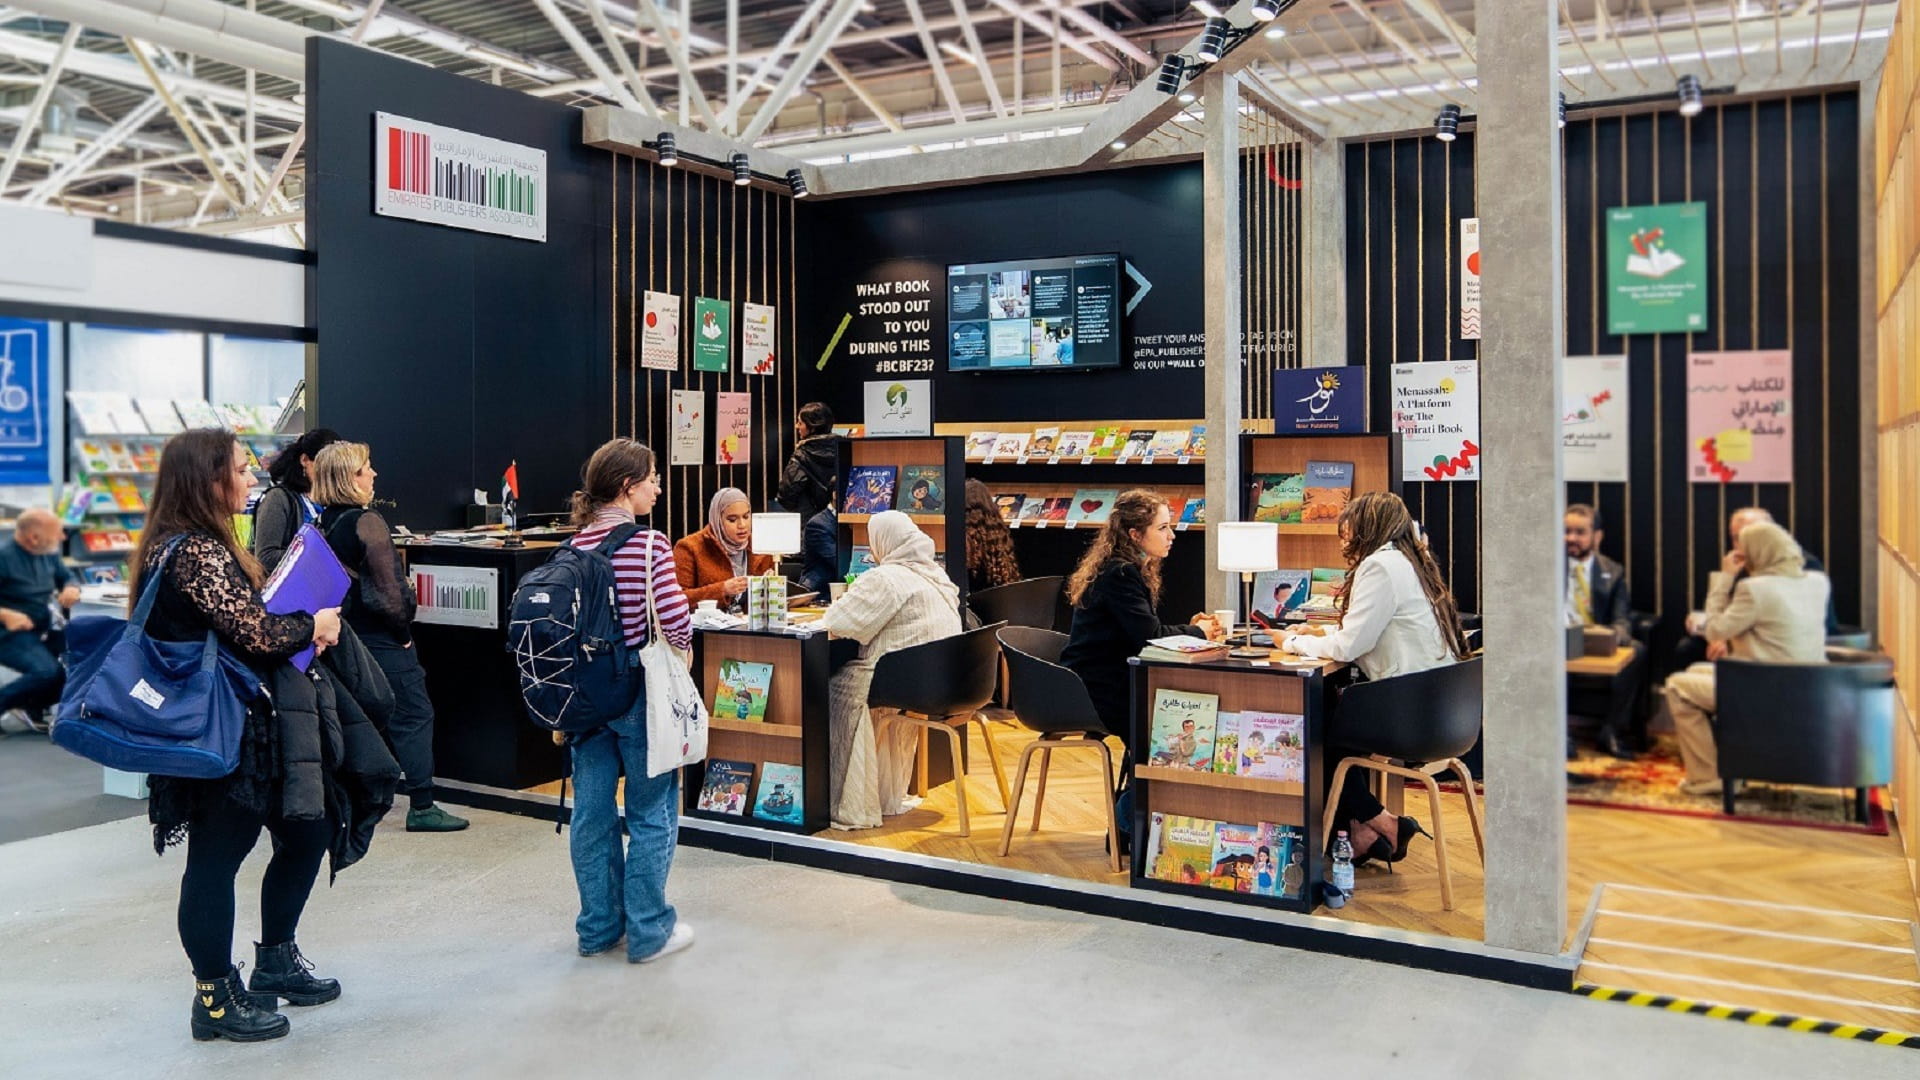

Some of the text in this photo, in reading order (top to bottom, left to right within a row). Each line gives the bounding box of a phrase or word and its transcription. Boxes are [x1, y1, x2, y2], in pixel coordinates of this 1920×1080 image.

[388, 191, 538, 229] EMIRATES PUBLISHERS ASSOCIATION
[856, 280, 930, 296] WHAT BOOK
[859, 300, 930, 315] STOOD OUT
[883, 319, 930, 334] TO YOU
[1134, 335, 1162, 344] TWEET
[1164, 334, 1187, 343] YOUR
[1189, 333, 1205, 343] ANS
[849, 339, 930, 355] DURING THIS
[876, 359, 934, 373] #BCBF23?
[1133, 361, 1146, 370] ON
[1147, 360, 1165, 370] OUR
[1397, 386, 1449, 397] Menassah:
[1408, 398, 1451, 409] Platform
[1397, 412, 1434, 421] For The
[1398, 424, 1463, 434] Emirati Book
